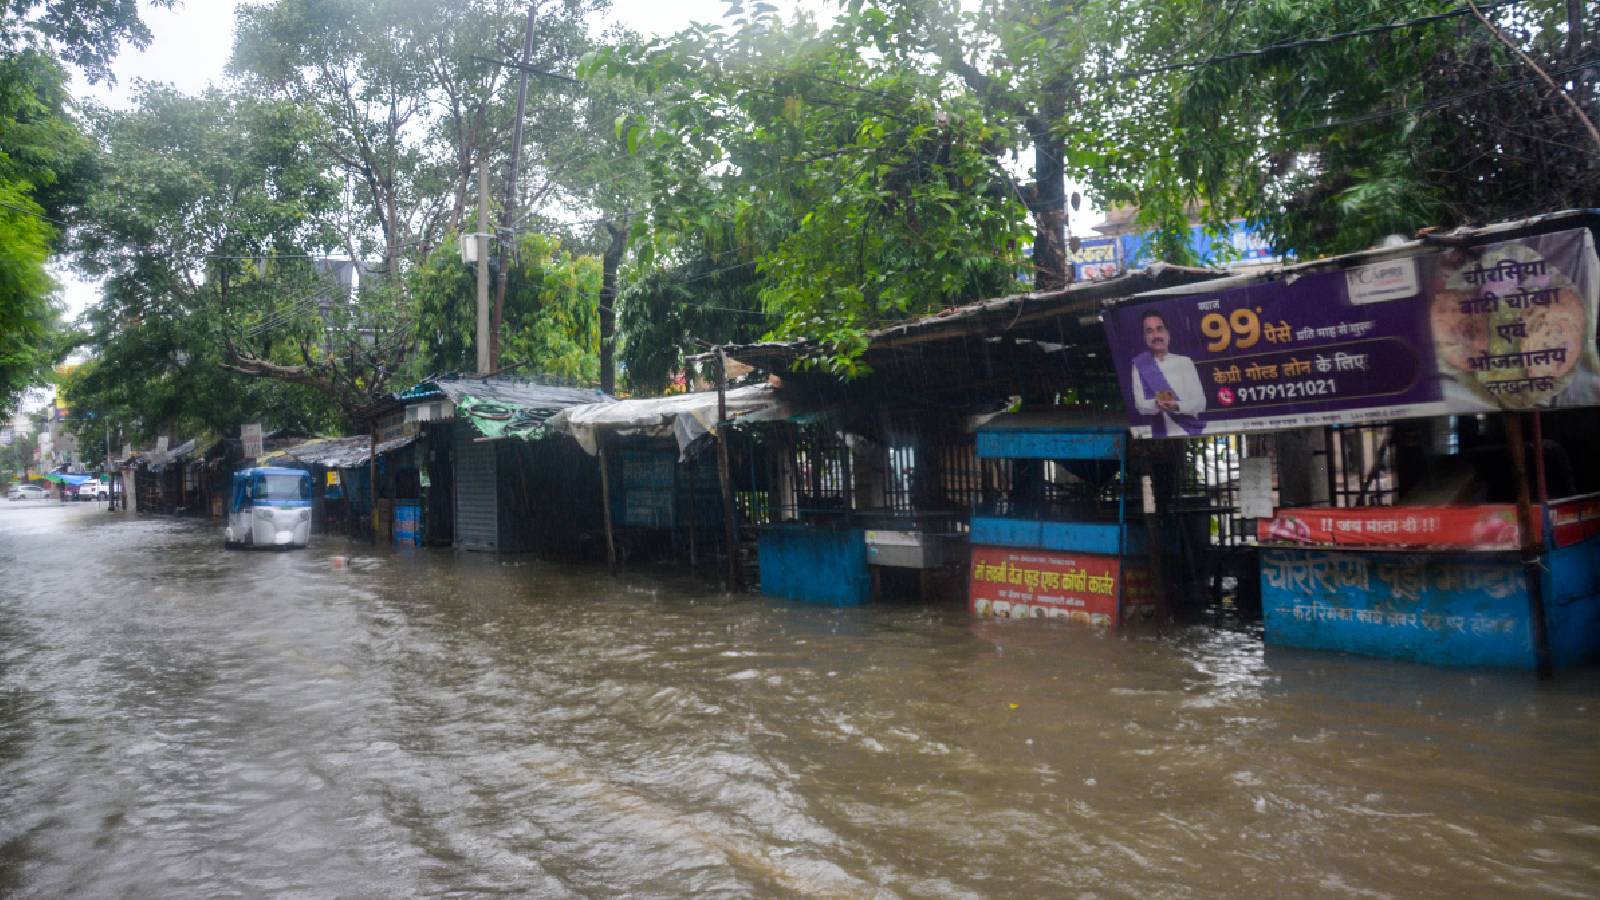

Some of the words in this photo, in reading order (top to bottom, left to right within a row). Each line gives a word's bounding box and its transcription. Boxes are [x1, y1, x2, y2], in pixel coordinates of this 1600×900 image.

[1496, 317, 1528, 344] एवं
[1245, 361, 1278, 382] गोल्ड
[1281, 357, 1312, 377] लोन
[1314, 354, 1332, 373] के
[1238, 378, 1337, 402] 9179121021
